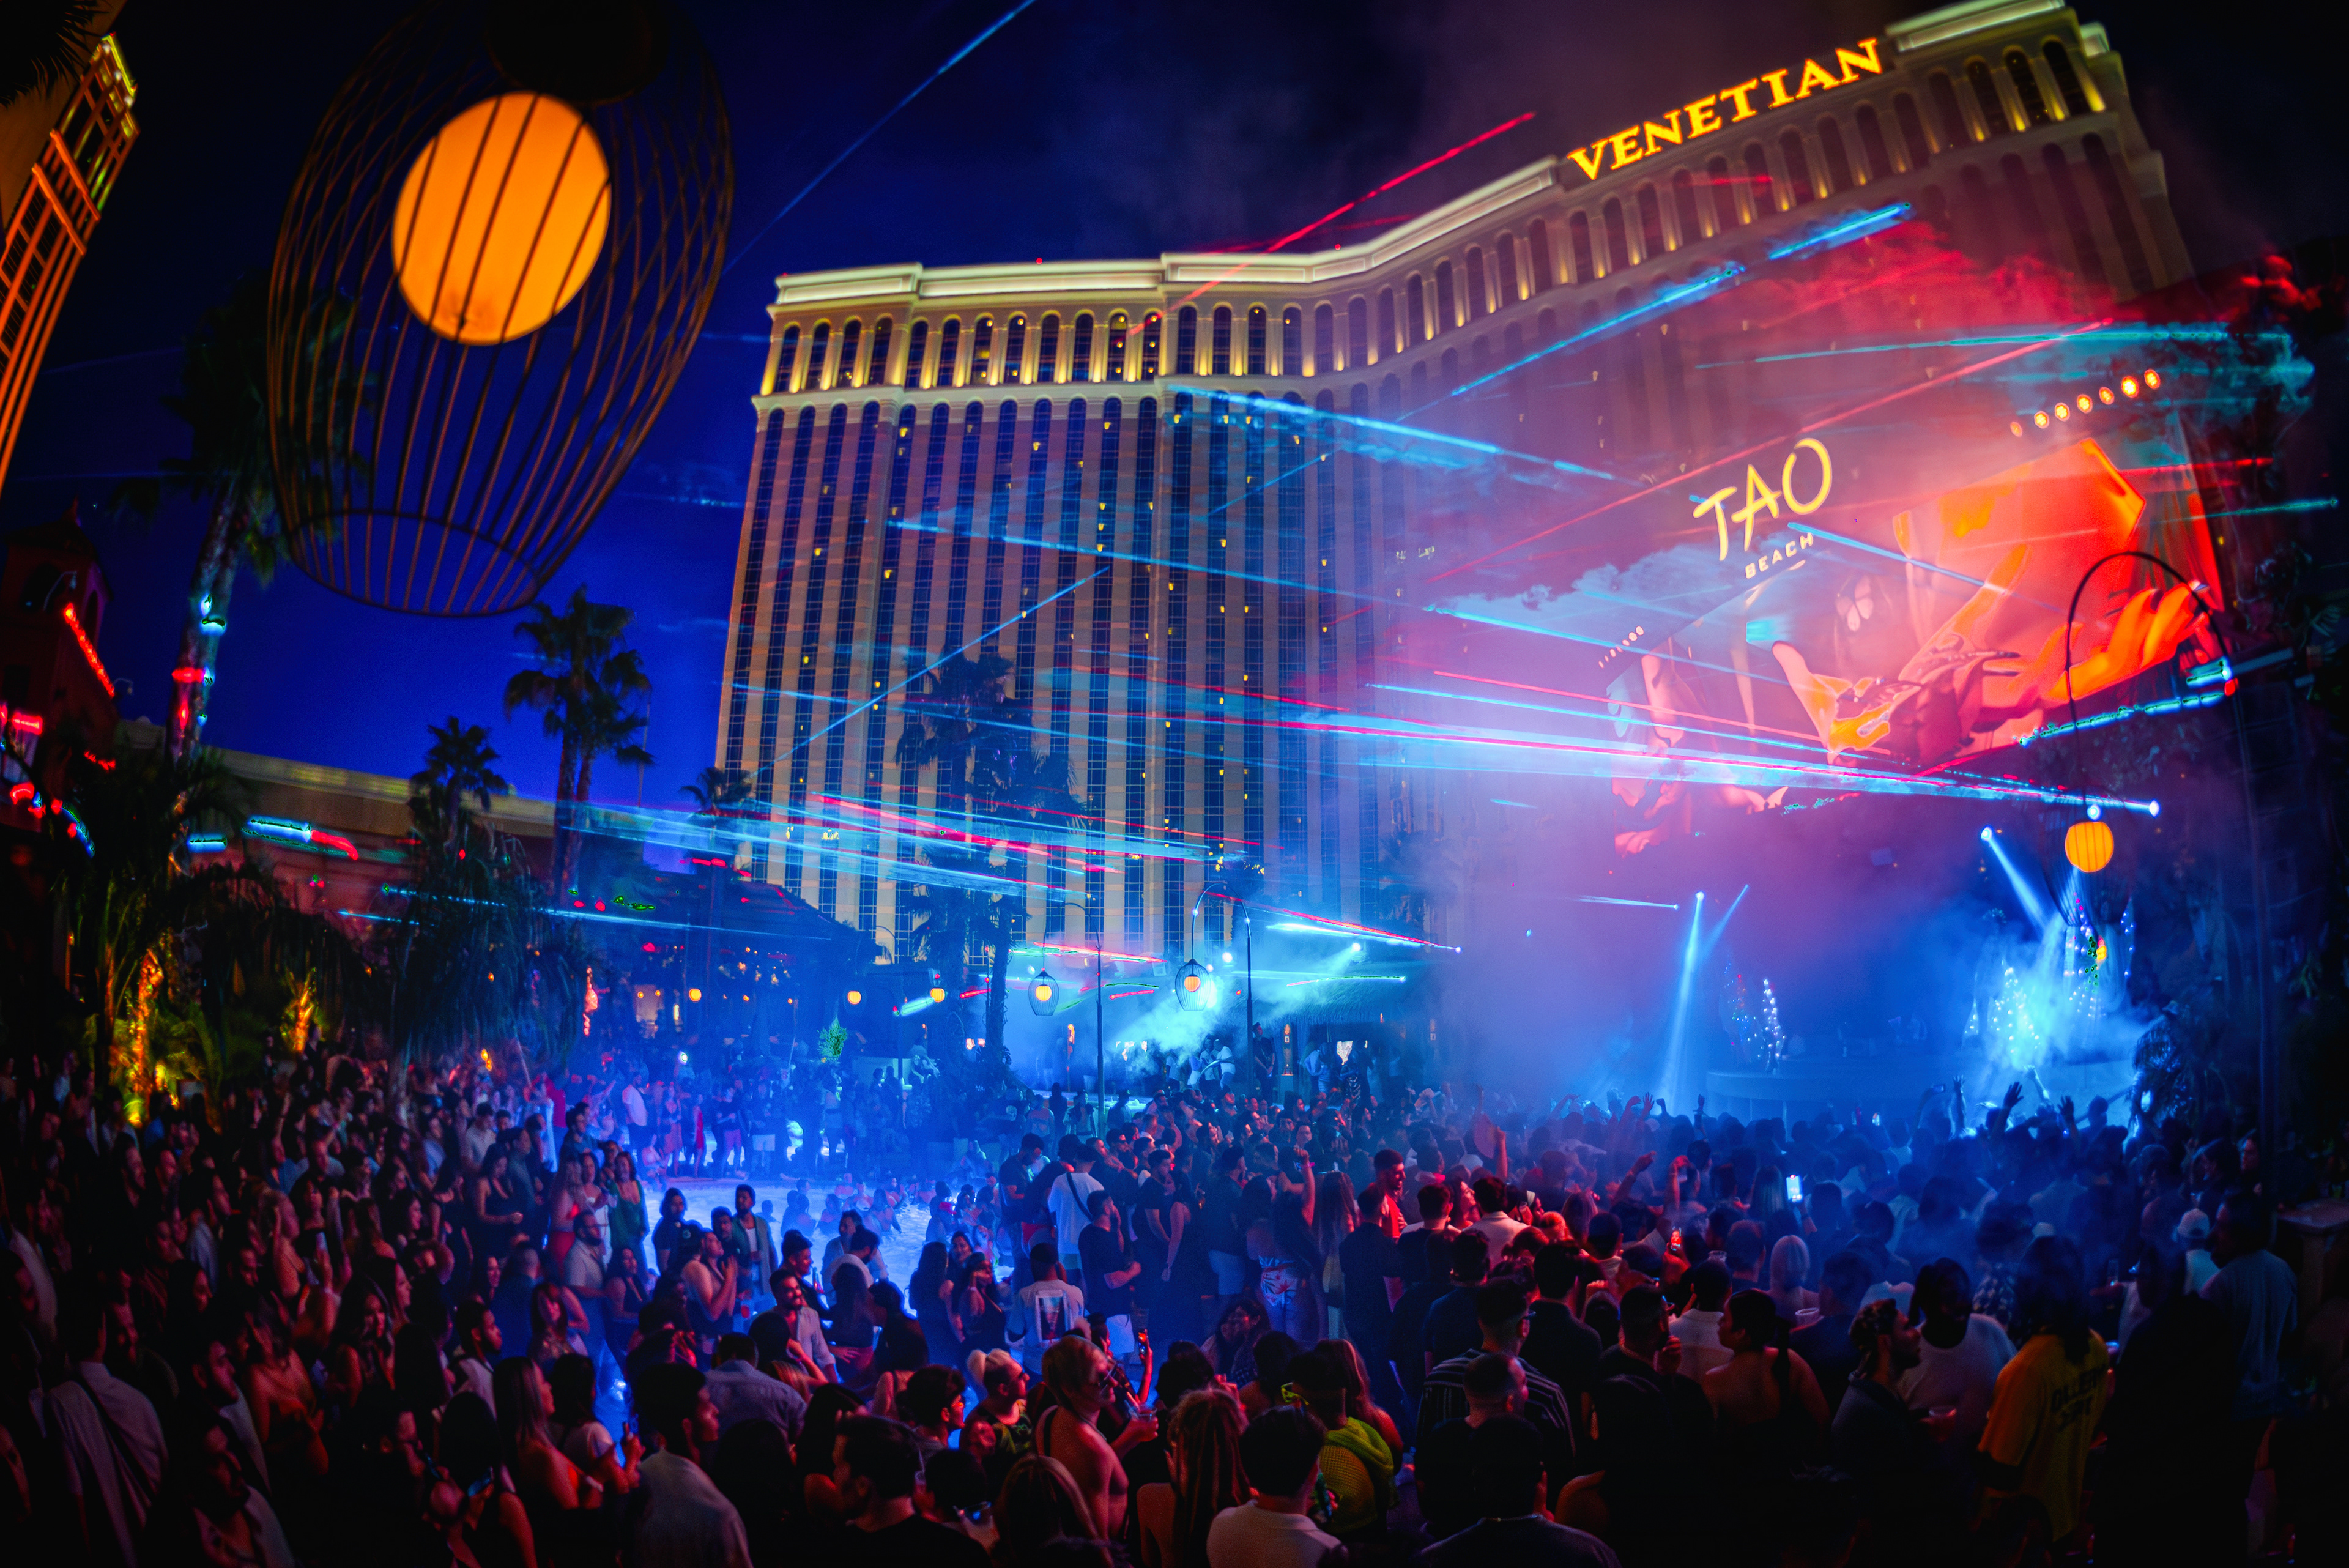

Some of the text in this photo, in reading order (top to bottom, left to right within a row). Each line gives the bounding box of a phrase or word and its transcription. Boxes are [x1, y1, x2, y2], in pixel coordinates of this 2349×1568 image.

[1567, 37, 1883, 180] VENETIAN
[1693, 438, 1833, 561] TAO
[1745, 532, 1813, 579] BEACH
